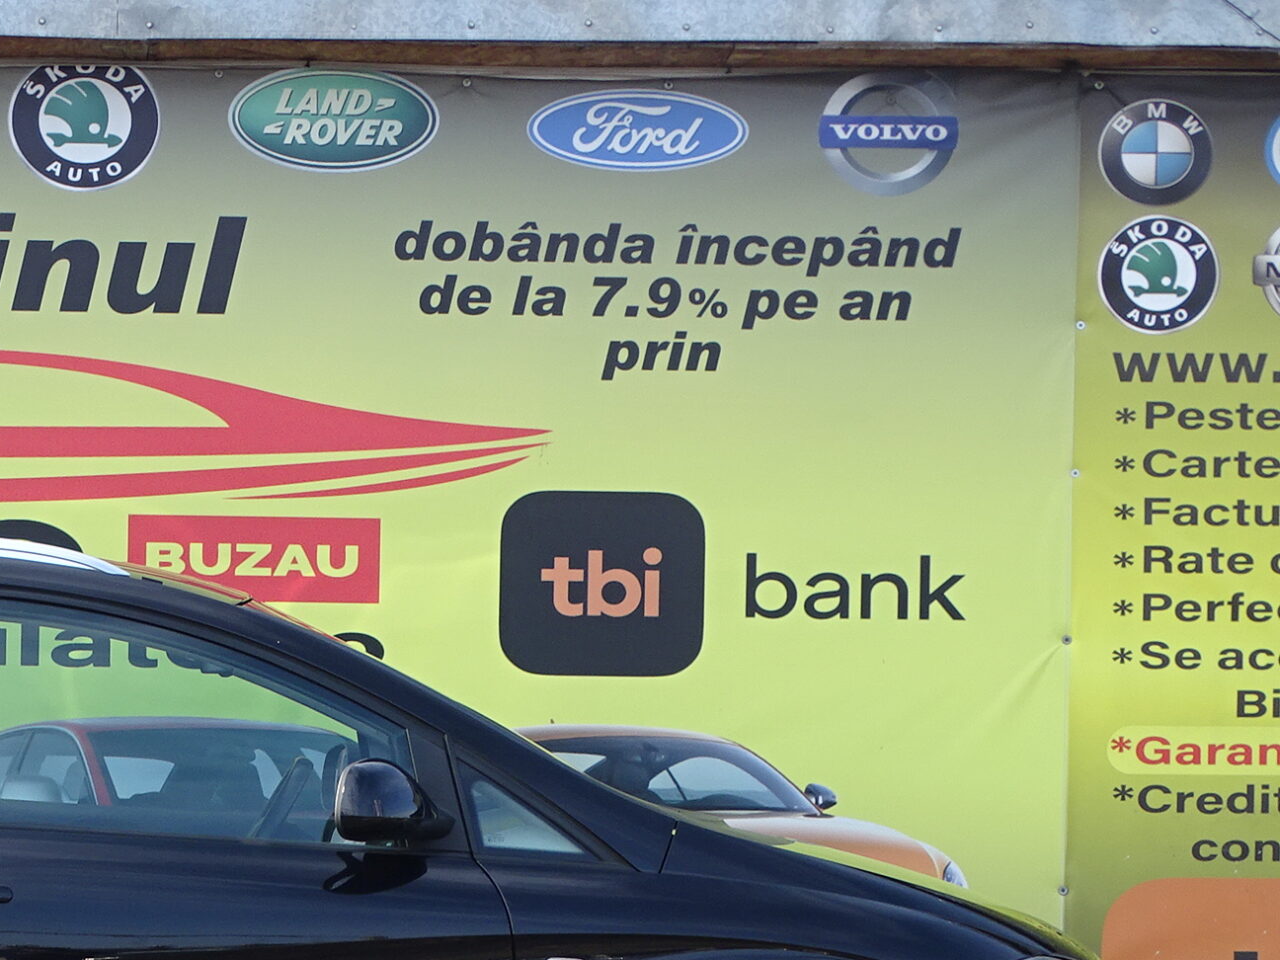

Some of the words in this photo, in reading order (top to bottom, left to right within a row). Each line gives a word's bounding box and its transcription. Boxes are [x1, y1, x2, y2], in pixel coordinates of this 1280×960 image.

[572, 101, 703, 155] Ford
[829, 123, 948, 142] VOLVO
[1111, 102, 1204, 137] BMW
[45, 160, 123, 183] AUTO
[394, 219, 656, 265] dobânda
[675, 223, 962, 278] începând
[418, 274, 493, 317] de
[511, 275, 567, 318] la
[591, 276, 729, 320] 7.9%
[740, 287, 819, 331] pe
[837, 289, 913, 322] an
[1126, 308, 1190, 328] AUTO
[601, 331, 722, 381] prin
[1113, 351, 1280, 384] www.
[145, 541, 360, 578] BUZAU
[540, 546, 663, 618] tbi
[745, 552, 966, 621] bank
[1113, 592, 1280, 623] Perfe
[1218, 648, 1280, 671] ac
[1191, 839, 1280, 863] con
